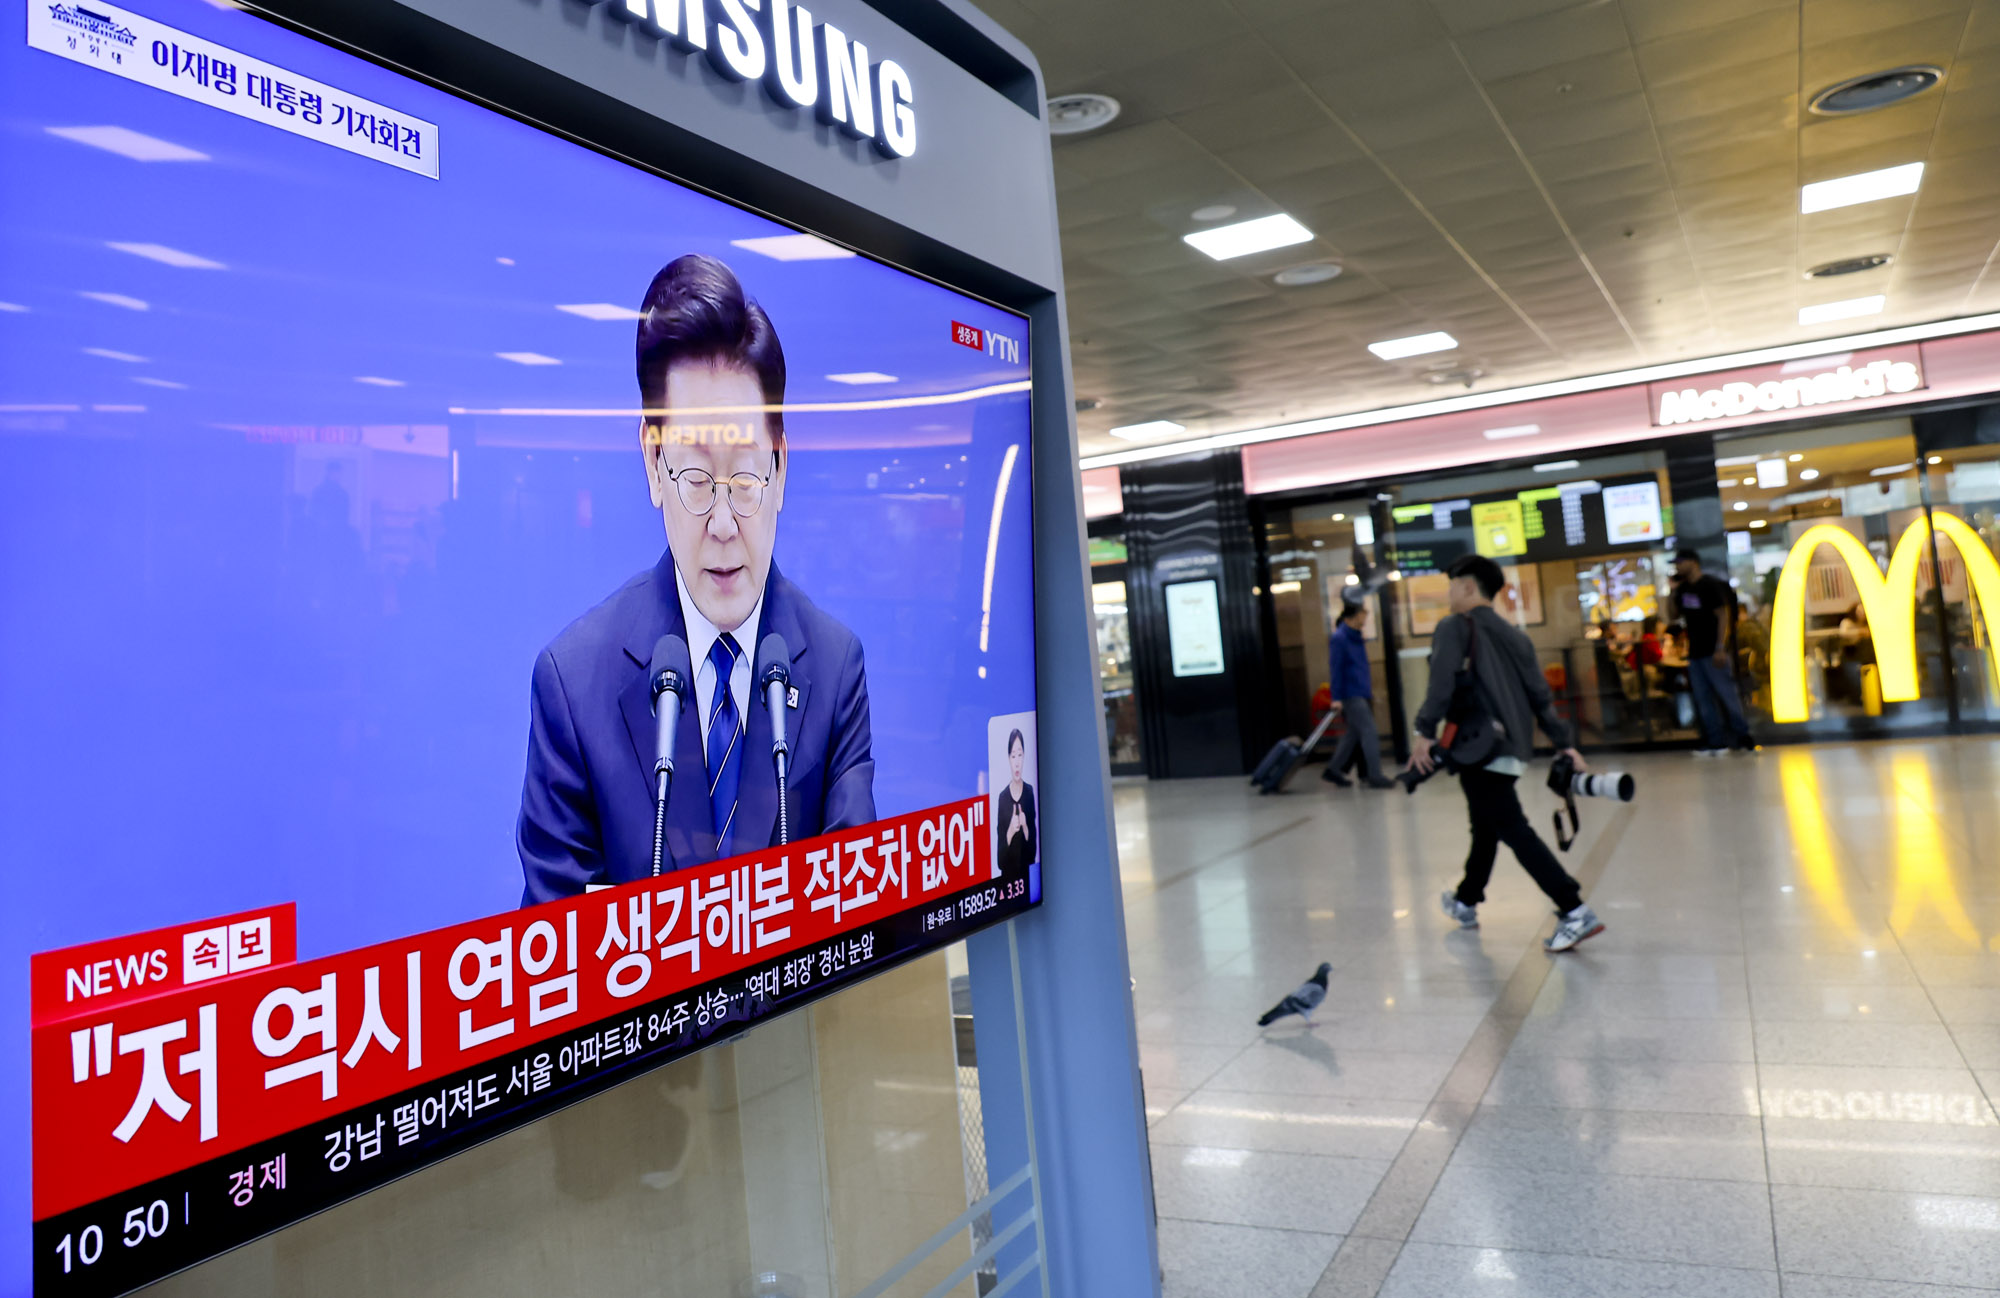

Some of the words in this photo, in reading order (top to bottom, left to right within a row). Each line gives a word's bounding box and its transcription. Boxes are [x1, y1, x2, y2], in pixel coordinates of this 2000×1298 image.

[152, 39, 237, 96] 이재명
[246, 71, 323, 126] 대통령
[331, 102, 422, 160] 기자회견
[957, 325, 978, 347] 생중계
[985, 329, 1019, 365] YTN
[1659, 359, 1920, 426] McDonald's
[958, 887, 998, 920] 1589.52
[1006, 878, 1025, 900] 3.33
[66, 949, 168, 1003] NEWS
[192, 926, 264, 969] 속보
[70, 1002, 219, 1144] "저
[251, 950, 423, 1102] 역시
[447, 910, 579, 1051] 연임
[594, 856, 801, 999] 생각해본
[803, 824, 912, 925] 적조차
[917, 801, 985, 893] 없어"
[55, 1224, 104, 1274] 10
[122, 1199, 170, 1248] 50
[228, 1152, 287, 1208] 경제
[323, 1112, 387, 1173] 강남
[392, 1073, 500, 1147] 떨어져도
[505, 1051, 554, 1096] 서울
[558, 1016, 643, 1077] 아파트값
[646, 1000, 691, 1042] 84주
[818, 942, 846, 978] 경신
[847, 930, 876, 970] 눈앞
